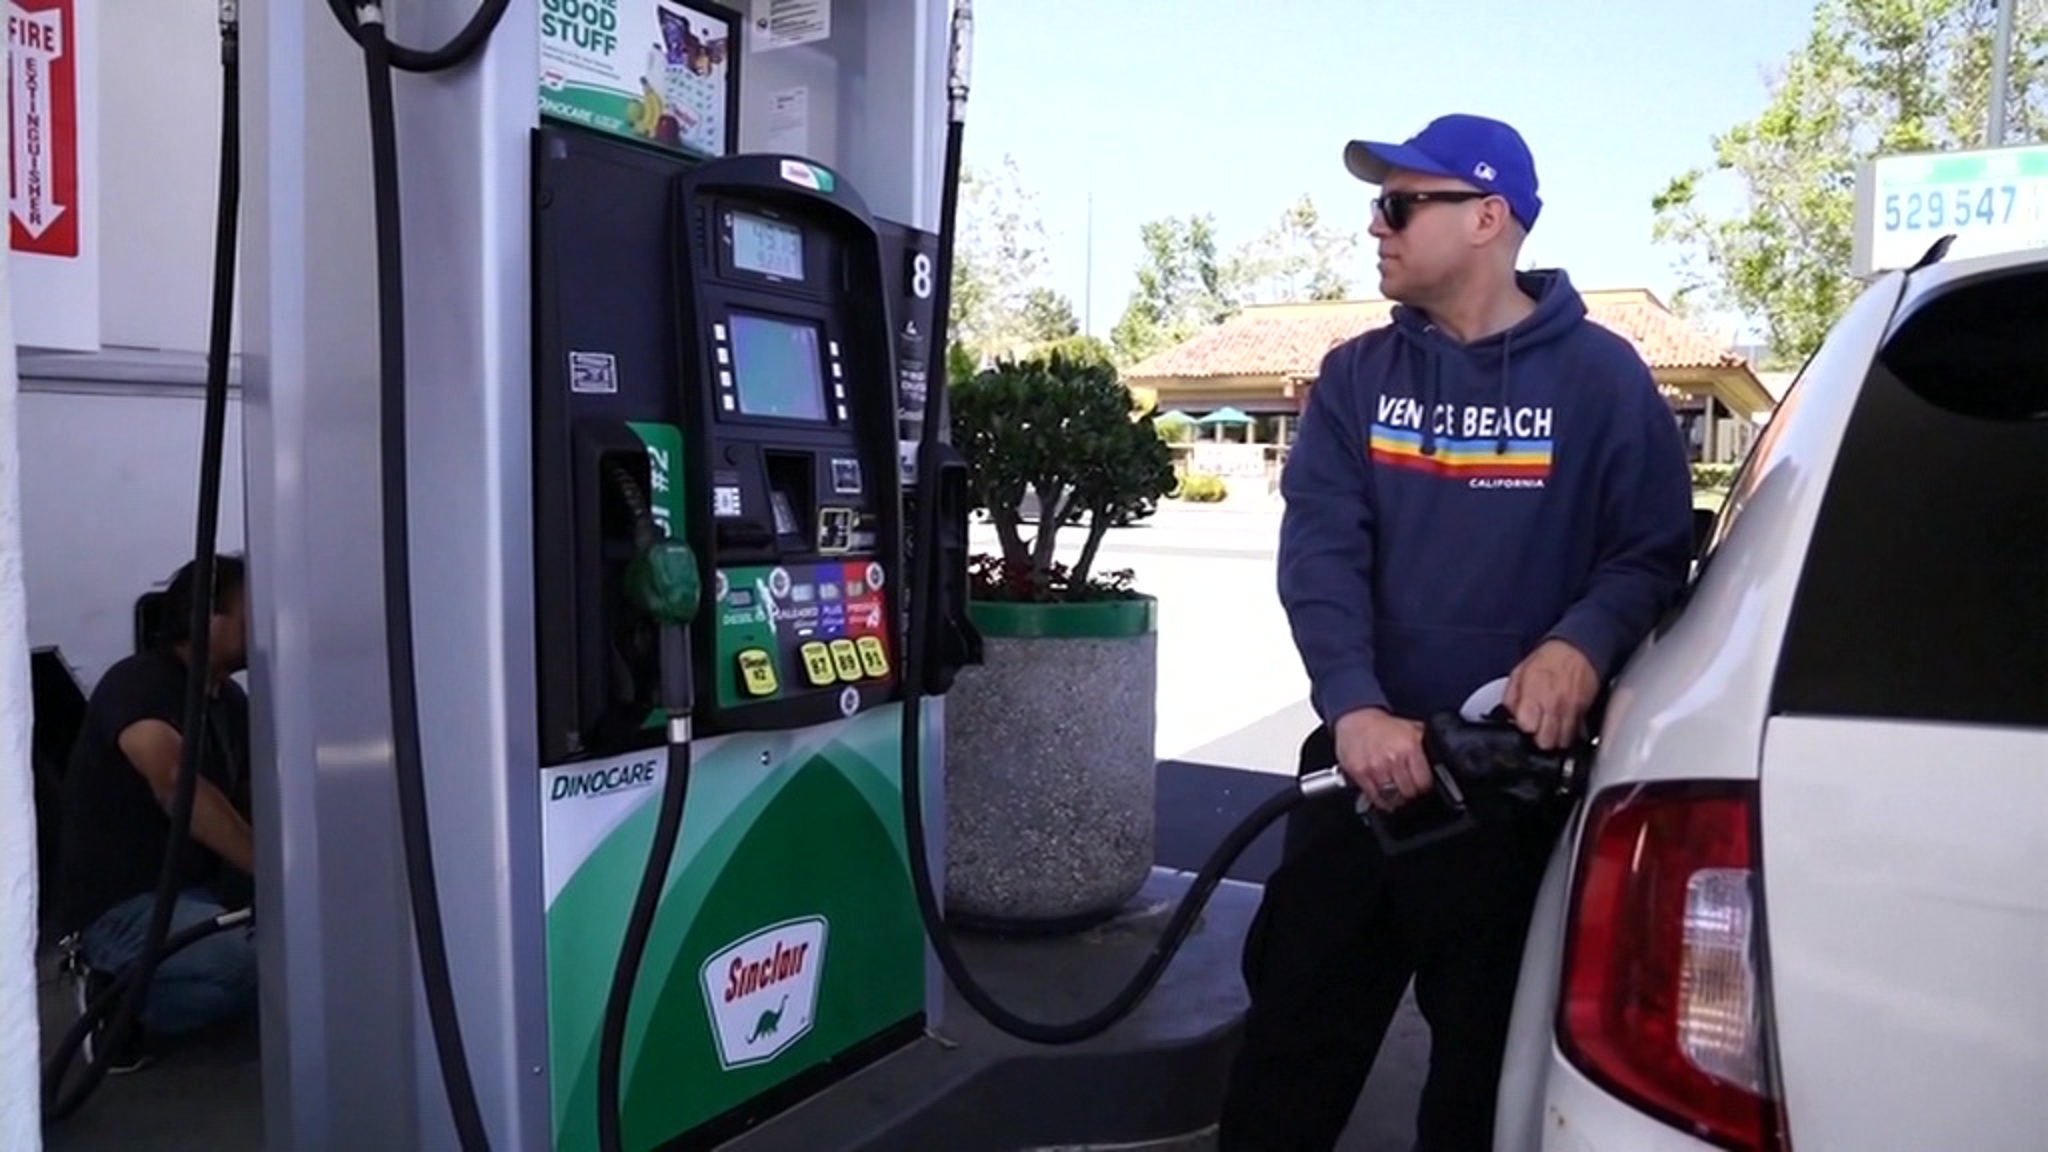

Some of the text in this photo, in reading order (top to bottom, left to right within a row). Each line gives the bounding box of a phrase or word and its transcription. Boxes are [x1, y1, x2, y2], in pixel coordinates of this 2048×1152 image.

[9, 16, 54, 52] FIRE
[541, 13, 617, 56] STUFF
[26, 58, 41, 225] EXTINGUISHER
[913, 254, 931, 298] 8
[1378, 395, 1552, 437] VENCE BEACH
[1469, 478, 1545, 489] CALIFORNIA
[551, 760, 657, 801] DINOCARE
[724, 941, 808, 1003] Sinclair
